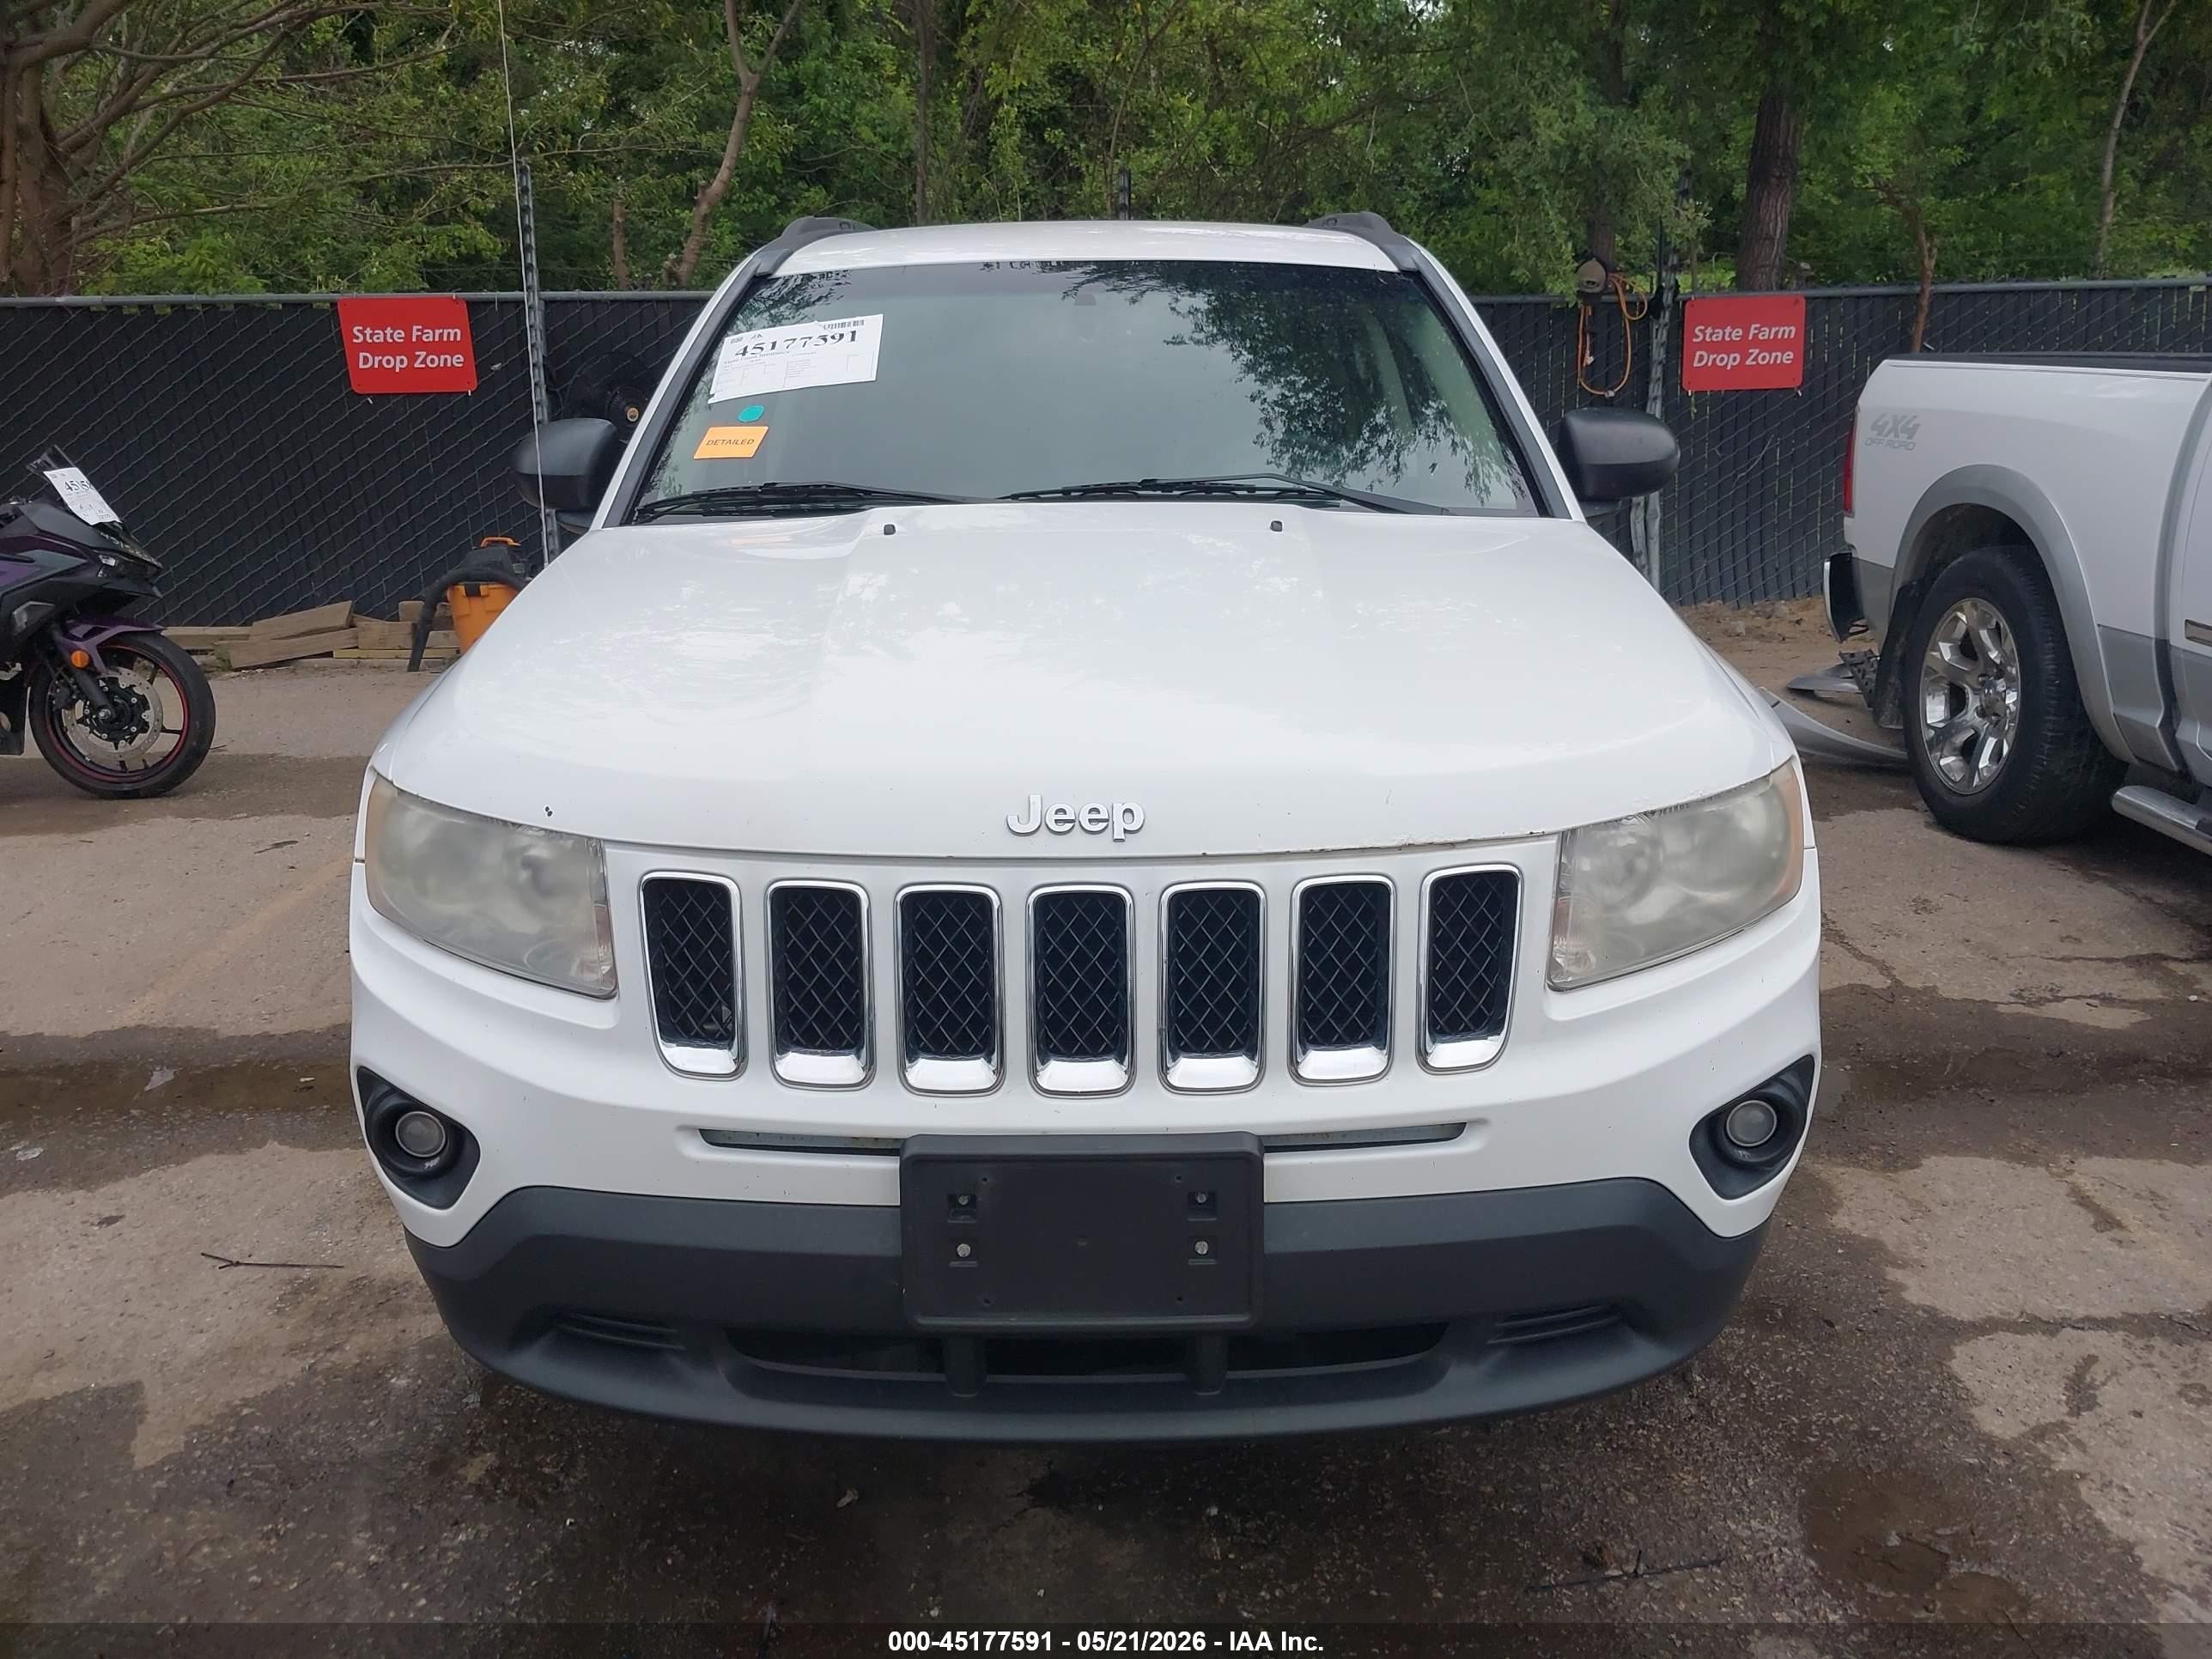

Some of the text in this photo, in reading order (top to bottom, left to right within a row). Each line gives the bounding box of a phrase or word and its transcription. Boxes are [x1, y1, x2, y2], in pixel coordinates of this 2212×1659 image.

[352, 325, 461, 343] State Farm
[1692, 324, 1796, 343] State Farm
[358, 350, 465, 373] Drop Zone
[1692, 349, 1794, 370] Drop Zone
[706, 438, 755, 447] DETAILED
[1007, 794, 1145, 842] Jeep
